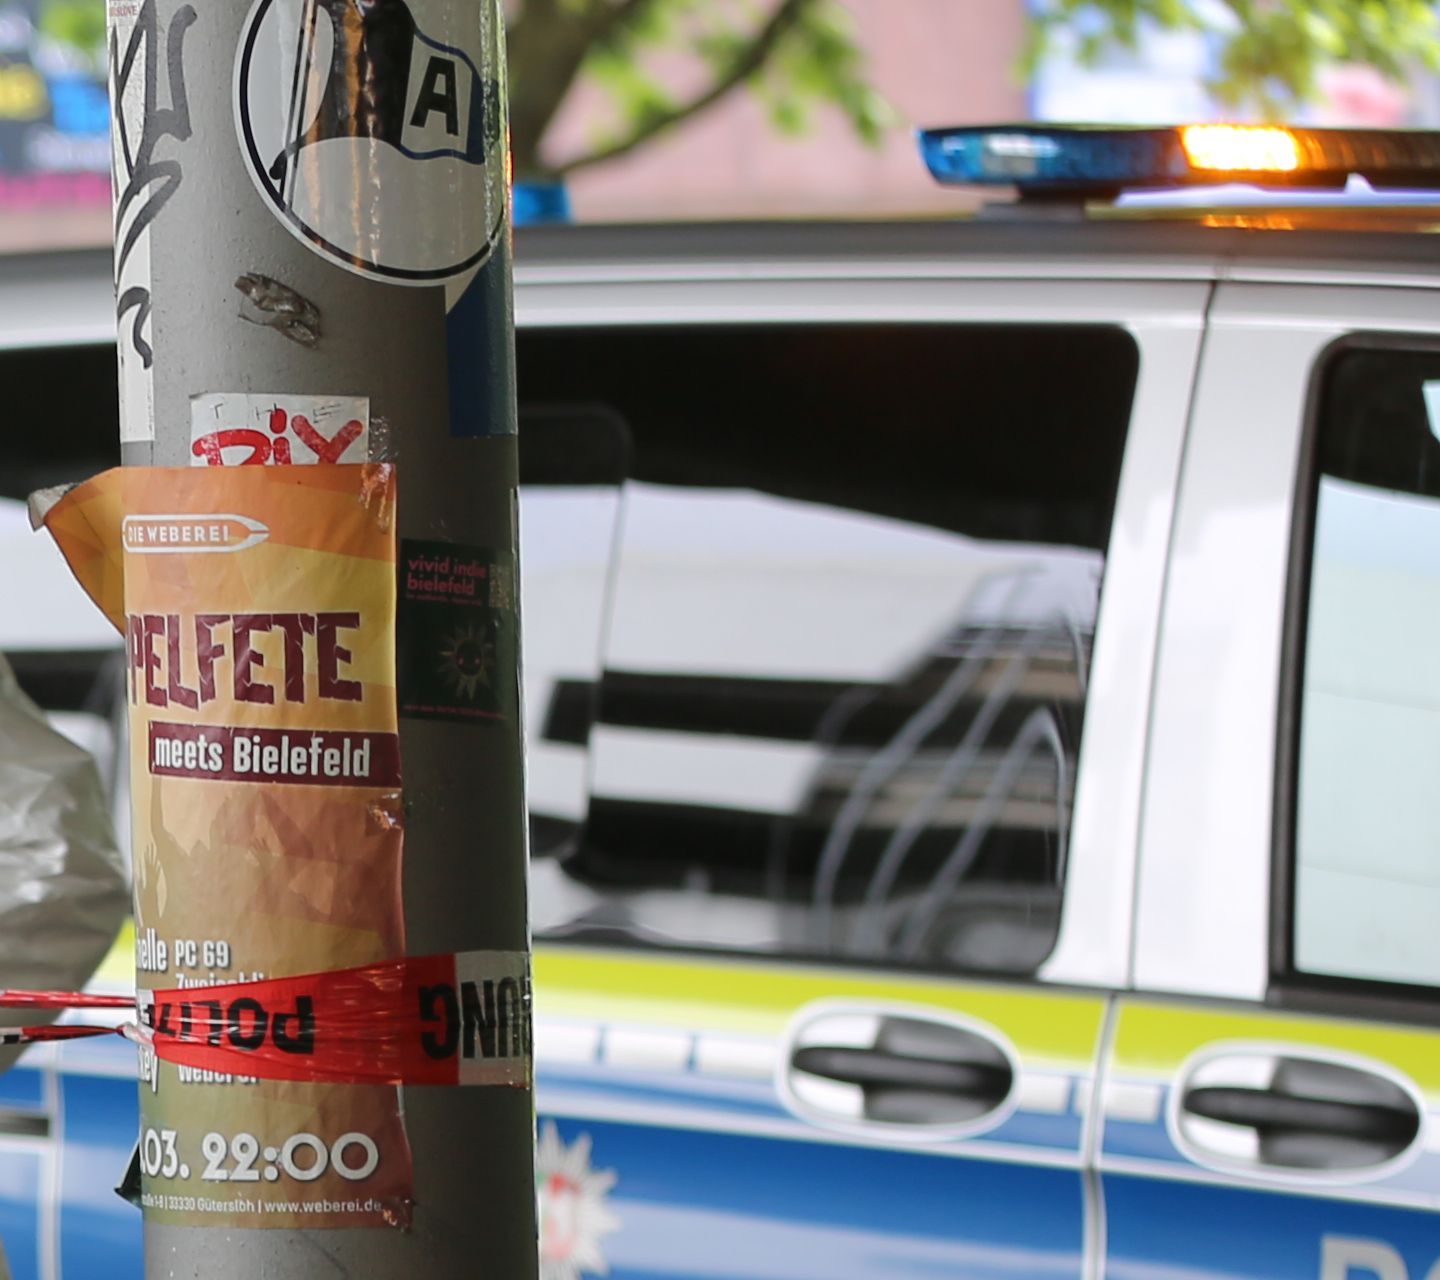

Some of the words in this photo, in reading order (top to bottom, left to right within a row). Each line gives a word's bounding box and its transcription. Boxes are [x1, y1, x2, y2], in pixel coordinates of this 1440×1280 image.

[410, 56, 459, 137] A
[129, 525, 144, 542] DIE
[147, 525, 229, 542] WEBEREI
[408, 555, 450, 574] vivid
[407, 573, 475, 596] bielefeld
[155, 734, 223, 773] meets
[233, 735, 370, 778] Bielefeld
[175, 939, 198, 968] PC
[202, 940, 230, 969] 69
[201, 1132, 378, 1181] 22:00
[197, 1197, 255, 1213] Gütersloh
[265, 1198, 382, 1213] www.weberei.de
